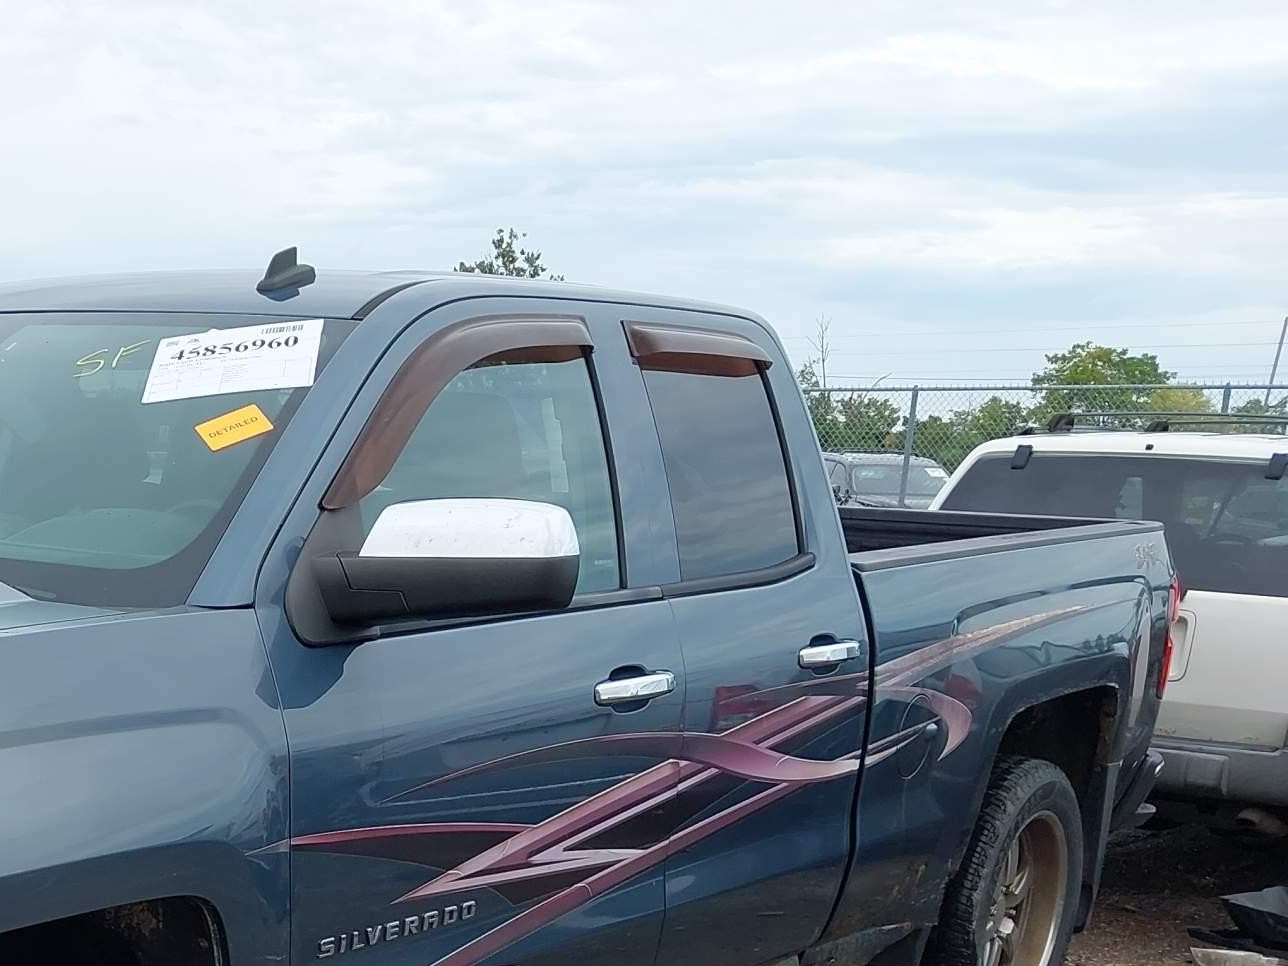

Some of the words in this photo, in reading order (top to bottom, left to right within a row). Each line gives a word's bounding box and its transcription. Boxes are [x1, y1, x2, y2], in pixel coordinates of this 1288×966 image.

[72, 338, 152, 377] SF
[170, 335, 300, 361] 45856960
[208, 416, 259, 439] DETAILED
[316, 900, 478, 960] SILVERADO
